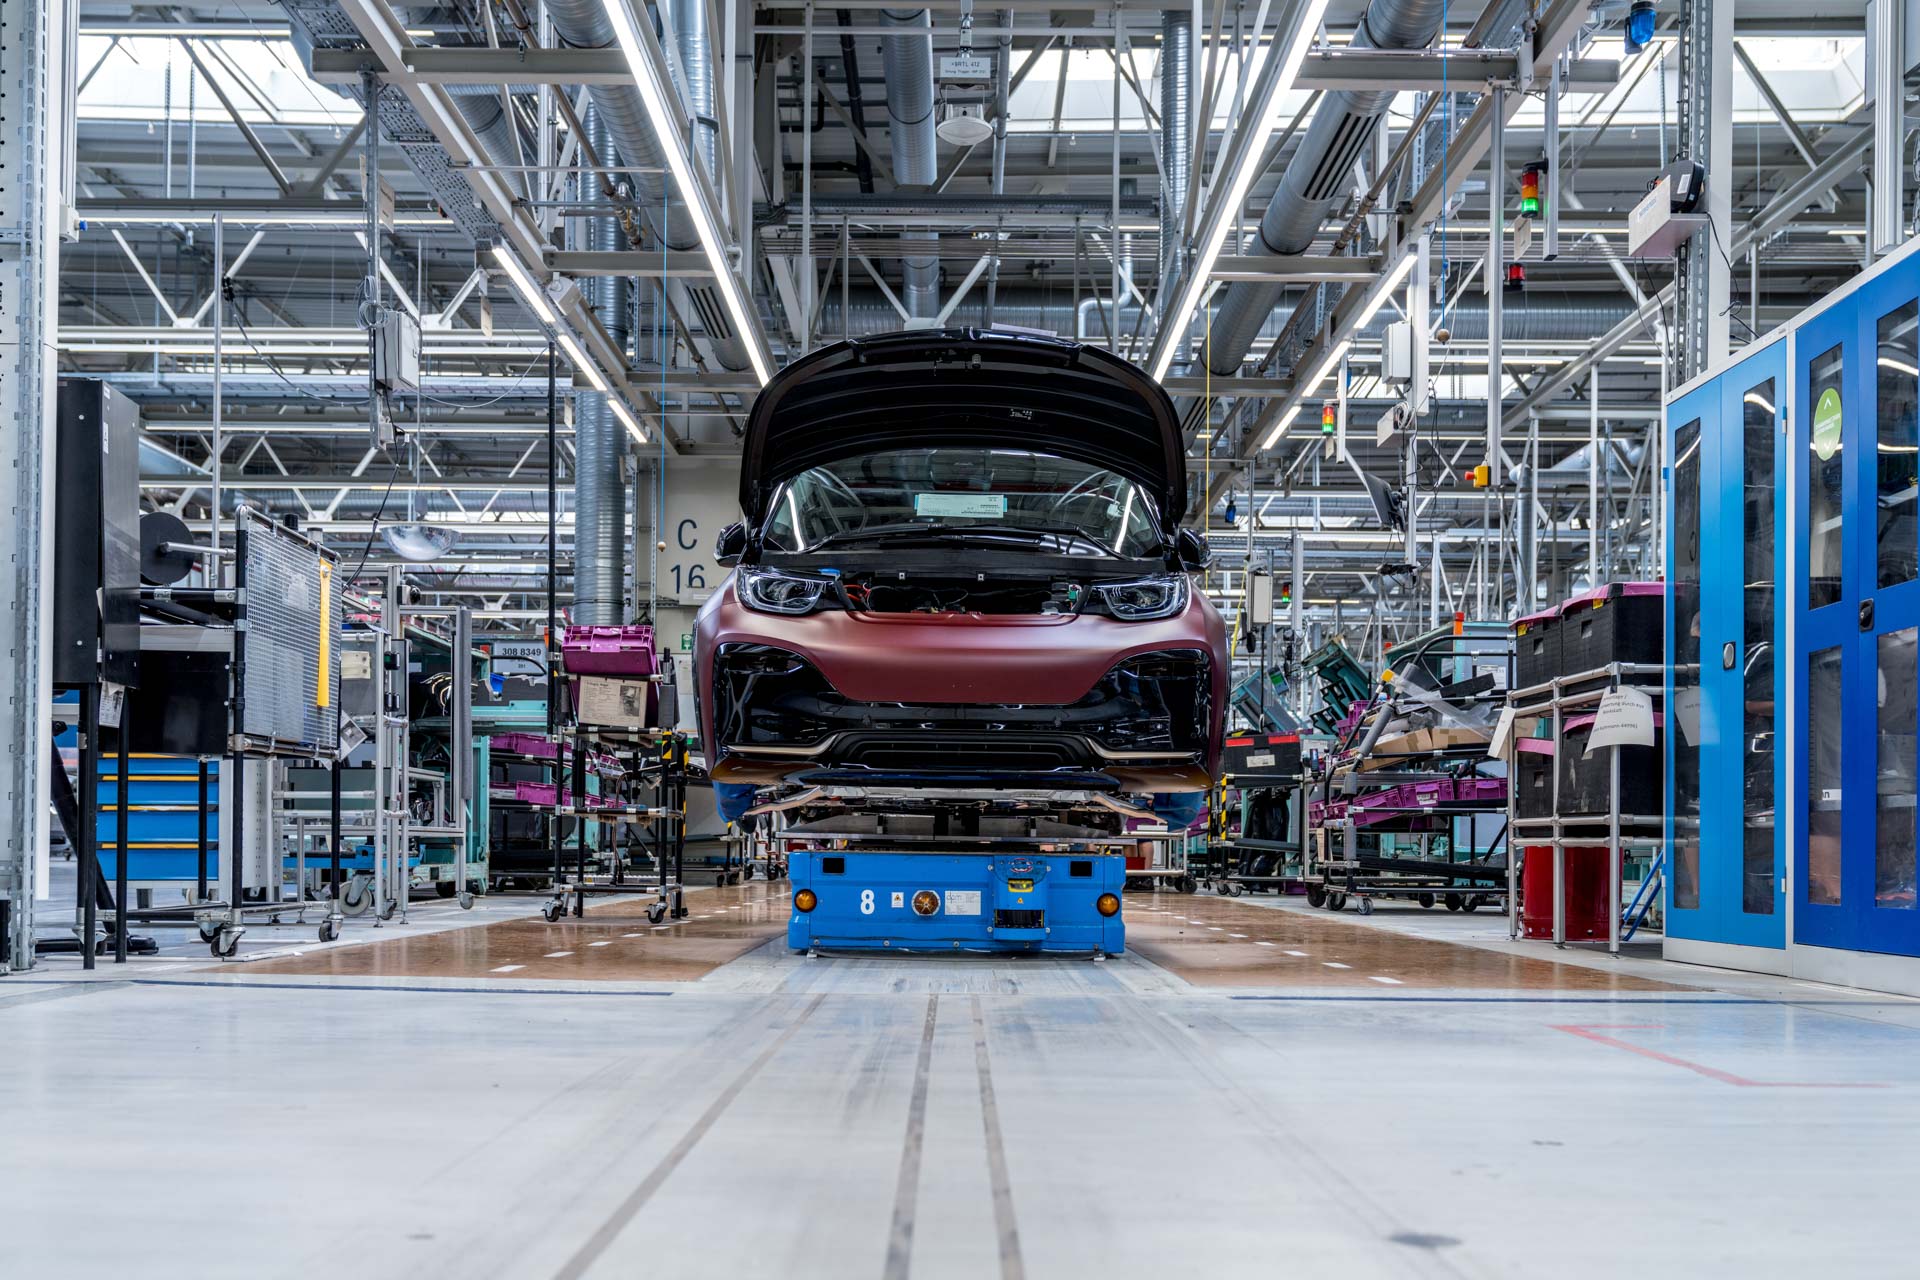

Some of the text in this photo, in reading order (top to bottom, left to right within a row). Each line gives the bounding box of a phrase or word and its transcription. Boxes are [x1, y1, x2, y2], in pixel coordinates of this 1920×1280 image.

[677, 519, 698, 550] C
[670, 563, 706, 594] 16
[502, 648, 542, 656] 308 8349
[860, 889, 875, 915] 8
